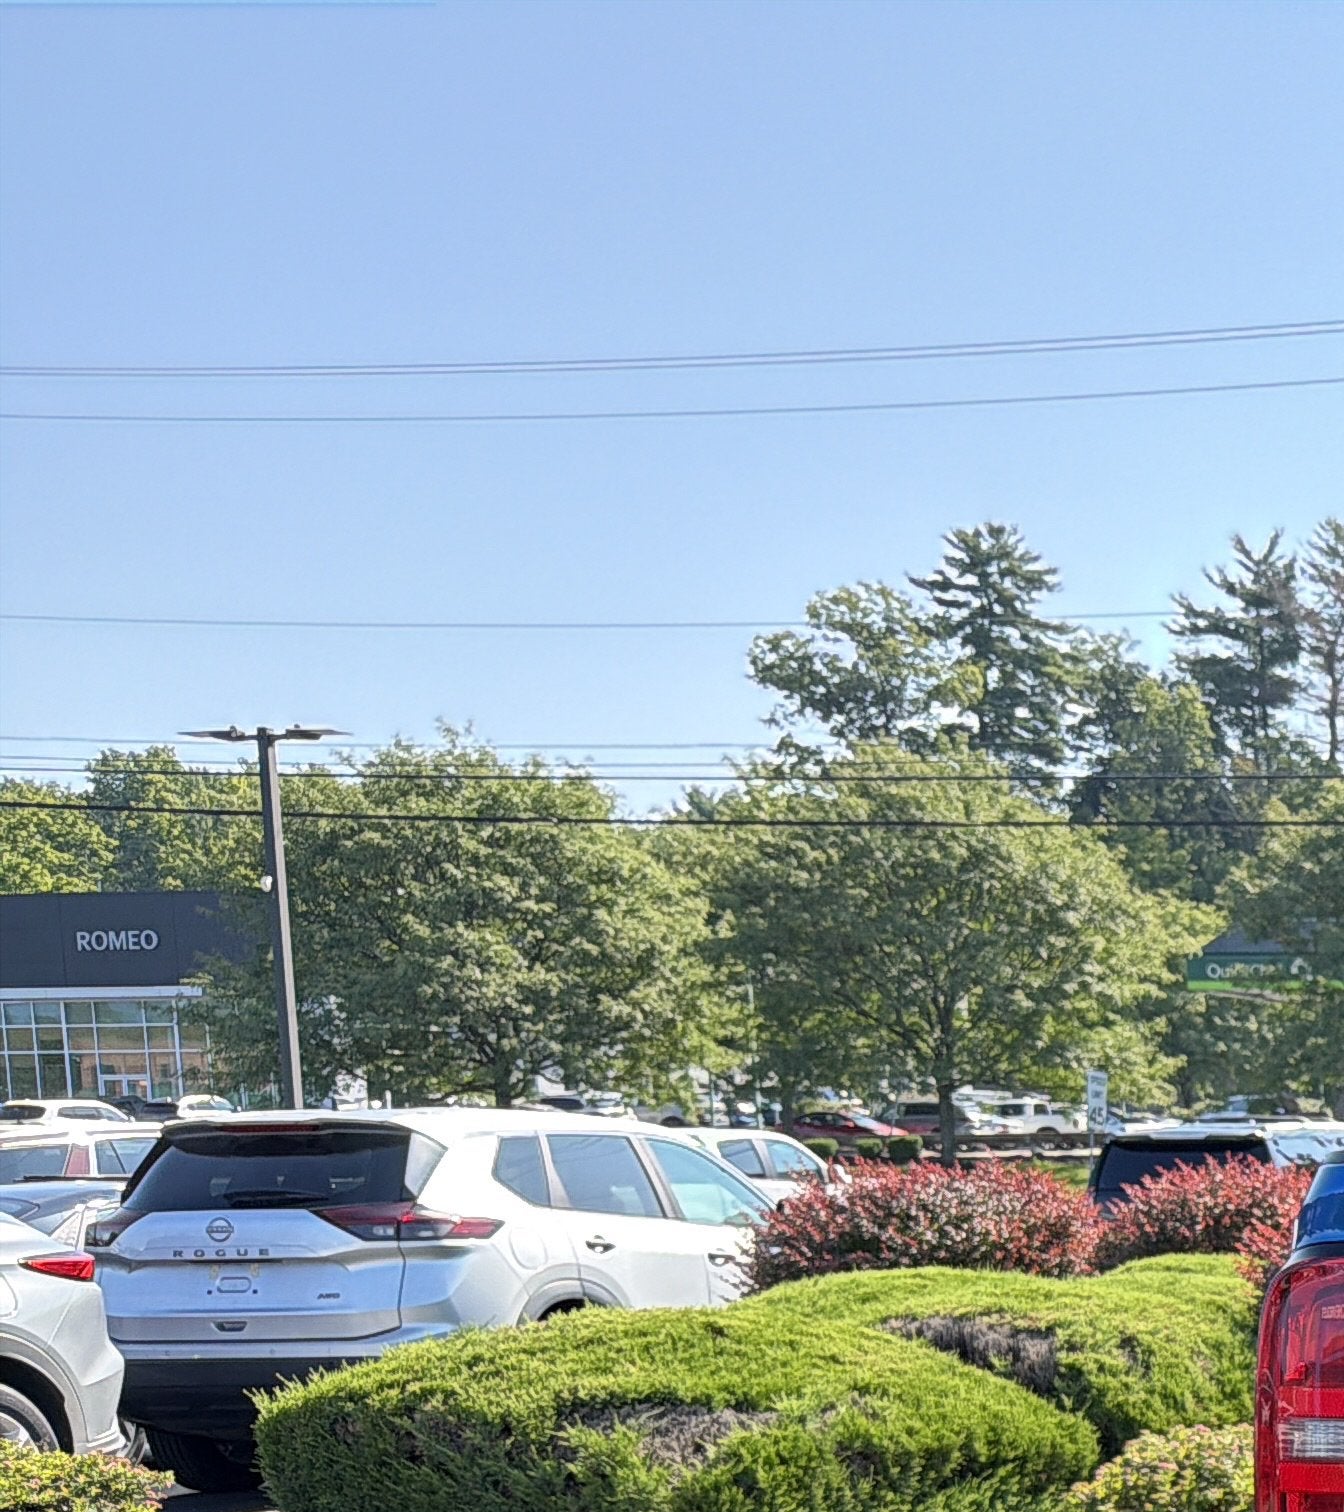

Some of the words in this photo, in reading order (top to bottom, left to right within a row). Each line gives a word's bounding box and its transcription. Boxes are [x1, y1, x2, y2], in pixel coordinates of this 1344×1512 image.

[76, 929, 158, 952] ROMEO
[1089, 1106, 1104, 1126] 45
[172, 1248, 270, 1258] ROGUE
